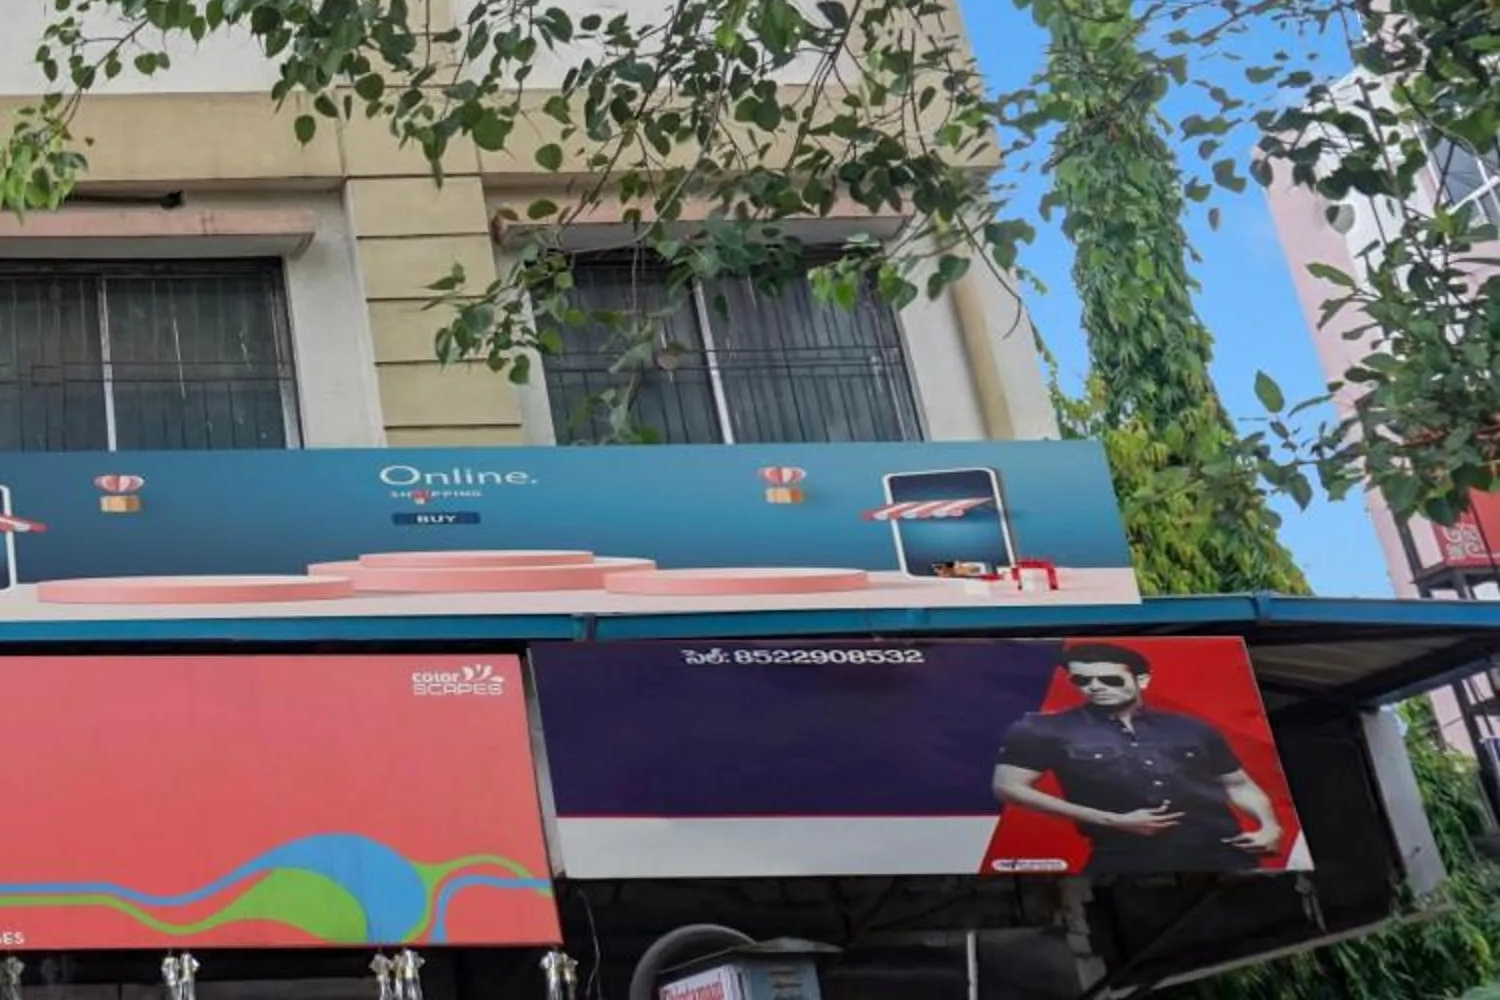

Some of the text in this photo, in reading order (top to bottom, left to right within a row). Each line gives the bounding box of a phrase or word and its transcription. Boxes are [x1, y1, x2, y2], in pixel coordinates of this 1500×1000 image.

[390, 489, 483, 498] SHPPING
[416, 514, 457, 524] BUY
[733, 648, 925, 665] 8522908532
[413, 683, 503, 695] SCAPES
